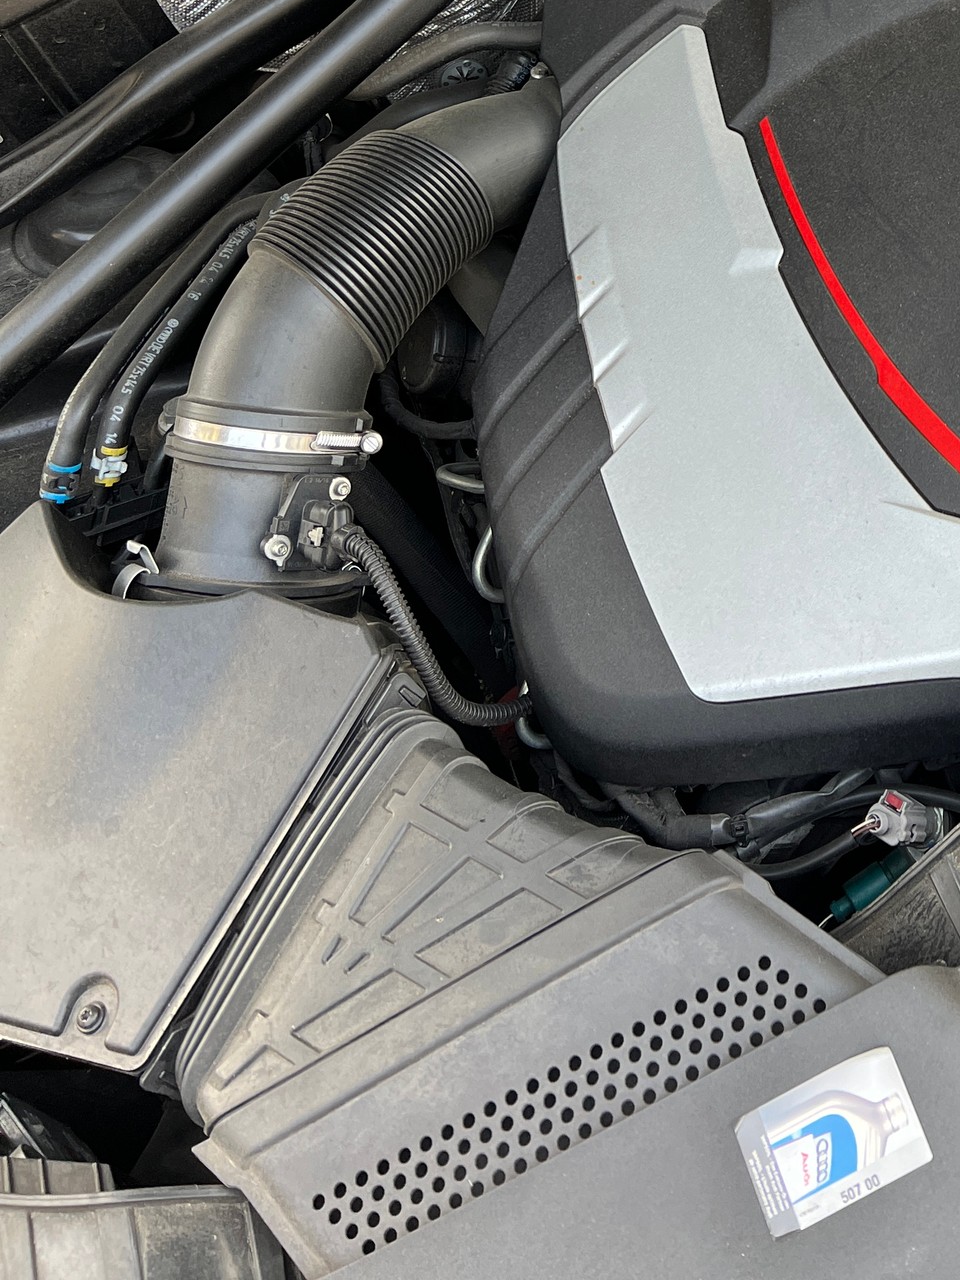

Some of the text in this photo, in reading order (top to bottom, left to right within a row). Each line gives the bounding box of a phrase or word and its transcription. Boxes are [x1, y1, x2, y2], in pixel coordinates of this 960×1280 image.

[801, 1152, 809, 1186] Audi
[840, 1174, 880, 1203] 507 00
